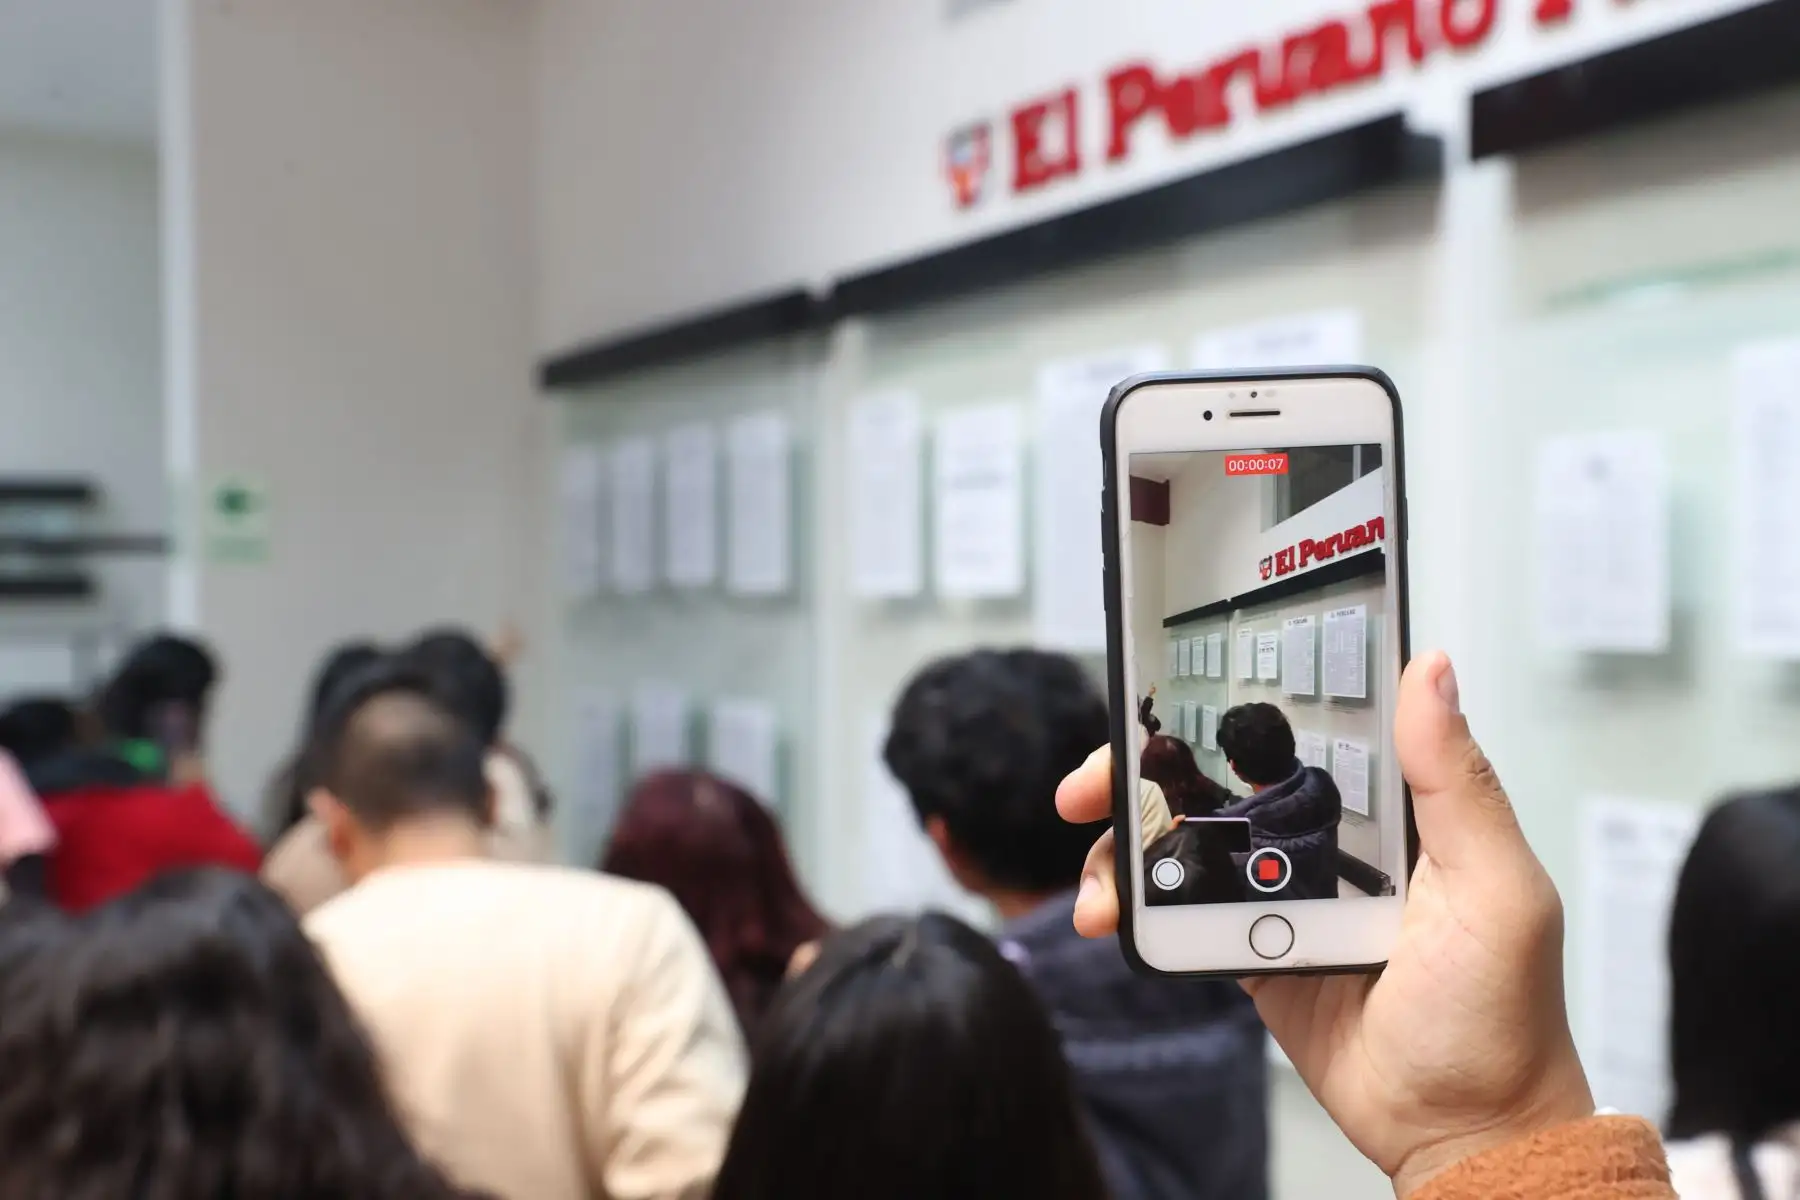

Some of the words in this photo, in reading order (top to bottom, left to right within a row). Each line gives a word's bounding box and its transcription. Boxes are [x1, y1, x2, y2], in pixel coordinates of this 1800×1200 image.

[1012, 87, 1077, 192] El
[1106, 0, 1497, 161] Peruano
[1229, 458, 1283, 472] 00:00:07
[1275, 545, 1295, 576] El
